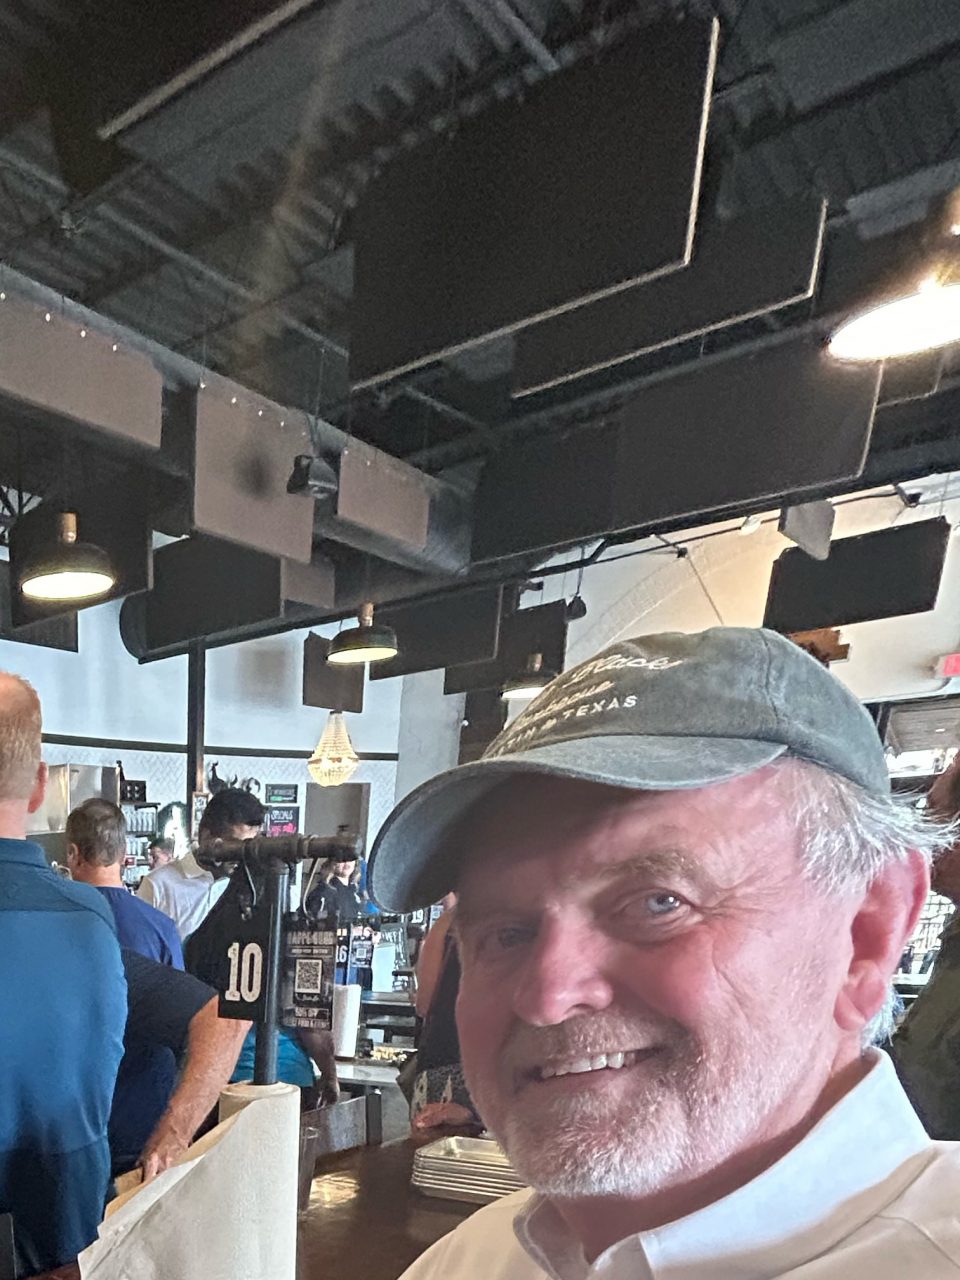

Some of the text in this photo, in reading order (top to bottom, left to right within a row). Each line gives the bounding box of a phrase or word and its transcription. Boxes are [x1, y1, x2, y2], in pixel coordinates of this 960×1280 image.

[562, 695, 638, 720] TEXAS
[411, 909, 424, 924] 19
[225, 942, 263, 1003] 10
